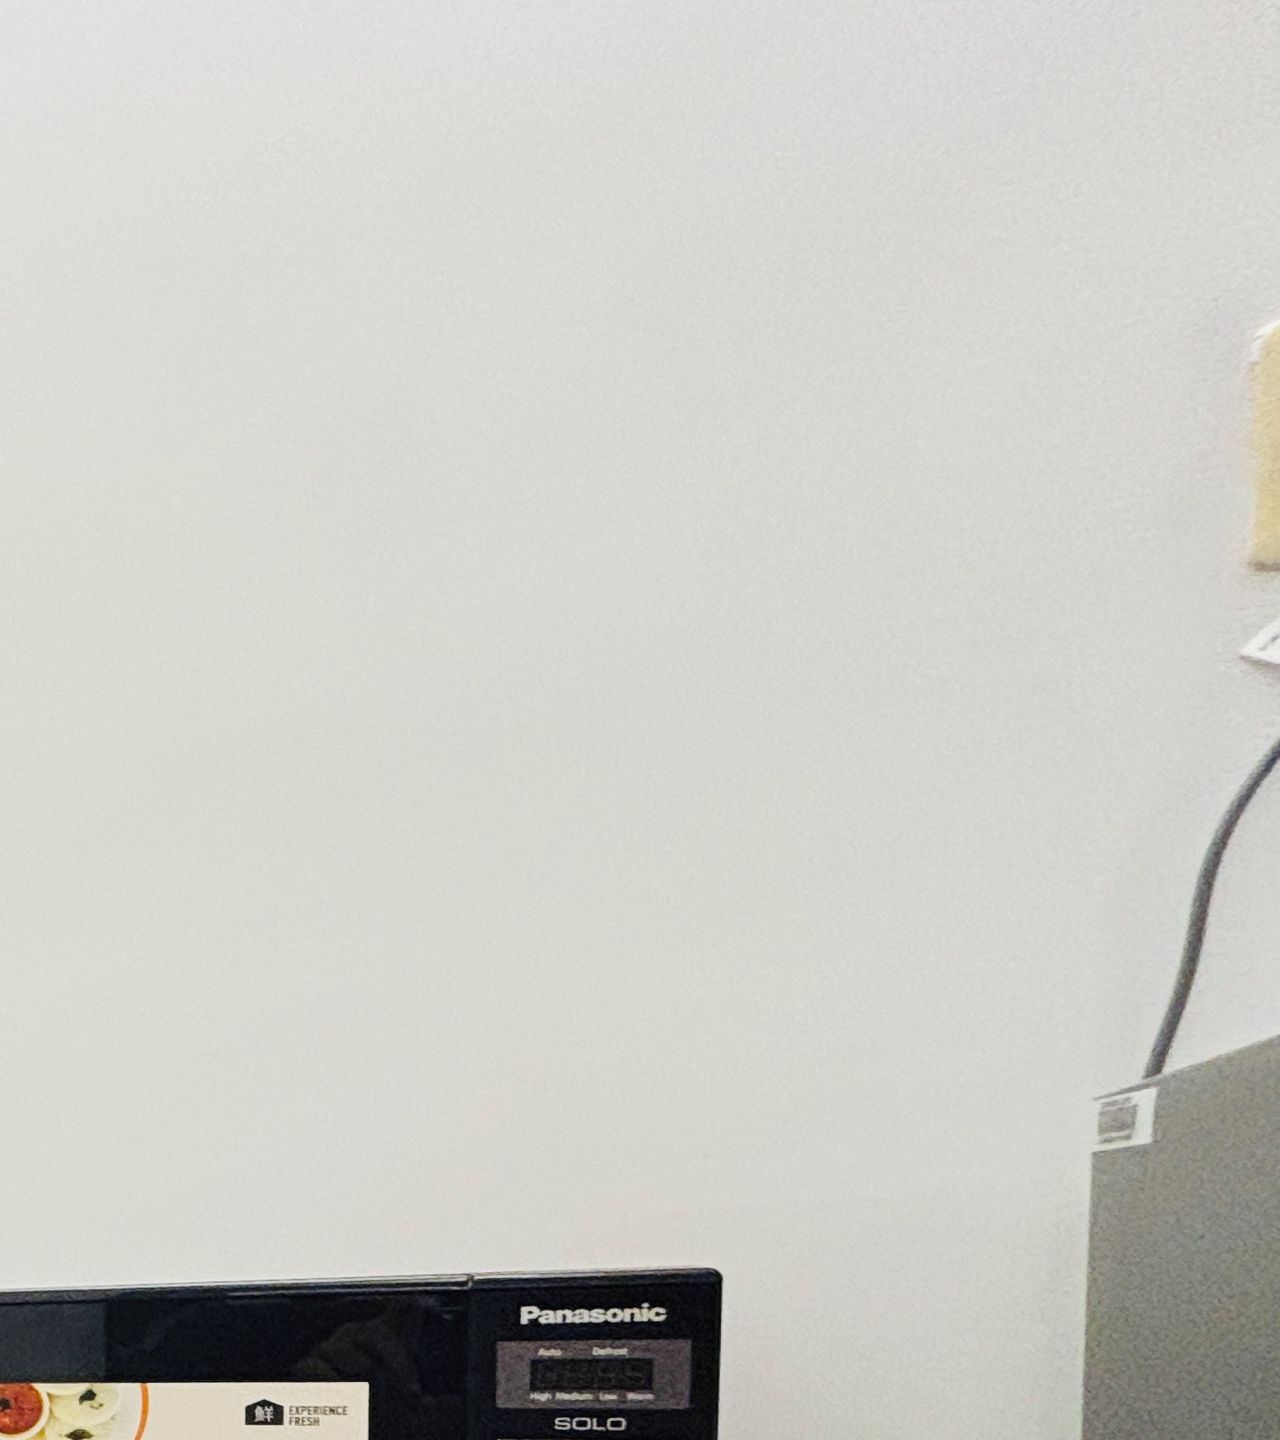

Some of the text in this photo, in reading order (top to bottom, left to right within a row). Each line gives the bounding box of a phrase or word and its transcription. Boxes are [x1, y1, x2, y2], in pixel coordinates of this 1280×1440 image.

[520, 1303, 667, 1325] Panasonic
[289, 1406, 348, 1415] EXPERIENCE
[289, 1417, 320, 1426] FRESH
[554, 1417, 627, 1431] SOLO
